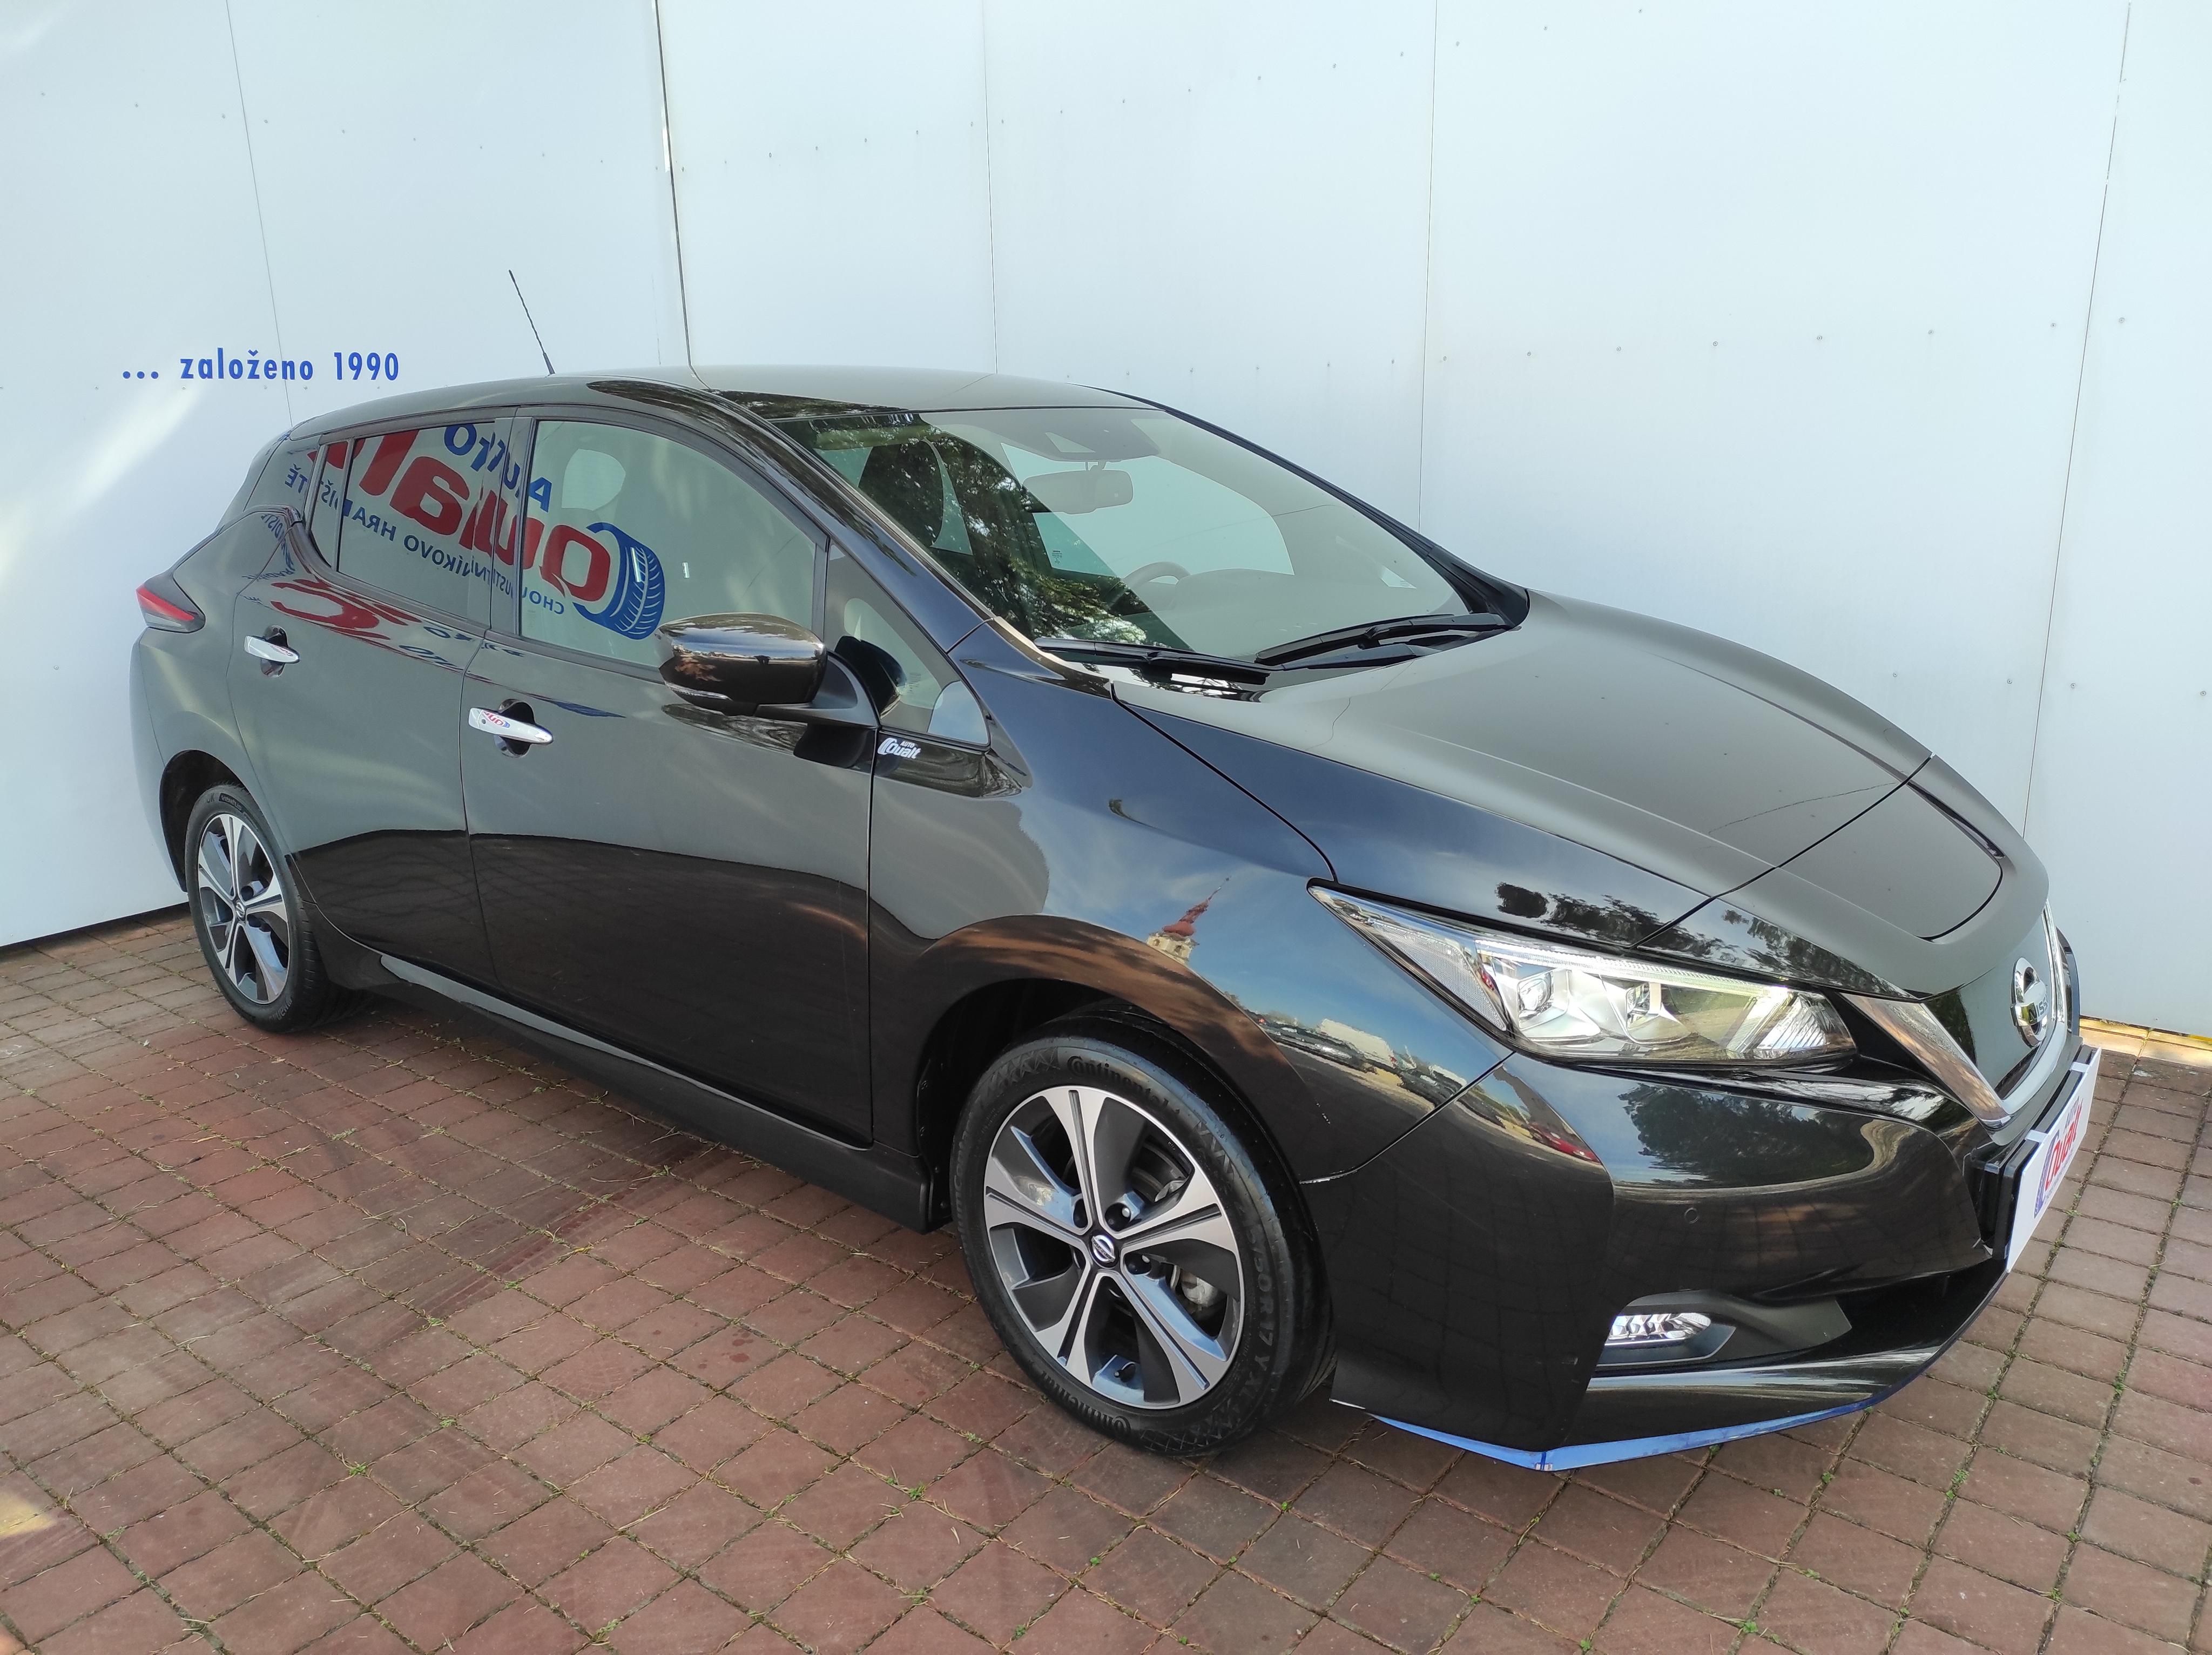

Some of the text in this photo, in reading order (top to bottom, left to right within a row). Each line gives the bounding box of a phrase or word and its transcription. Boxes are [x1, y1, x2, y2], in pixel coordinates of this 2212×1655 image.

[180, 347, 314, 381] založeno
[333, 352, 400, 381] 1990
[2028, 992, 2049, 1023] NISS
